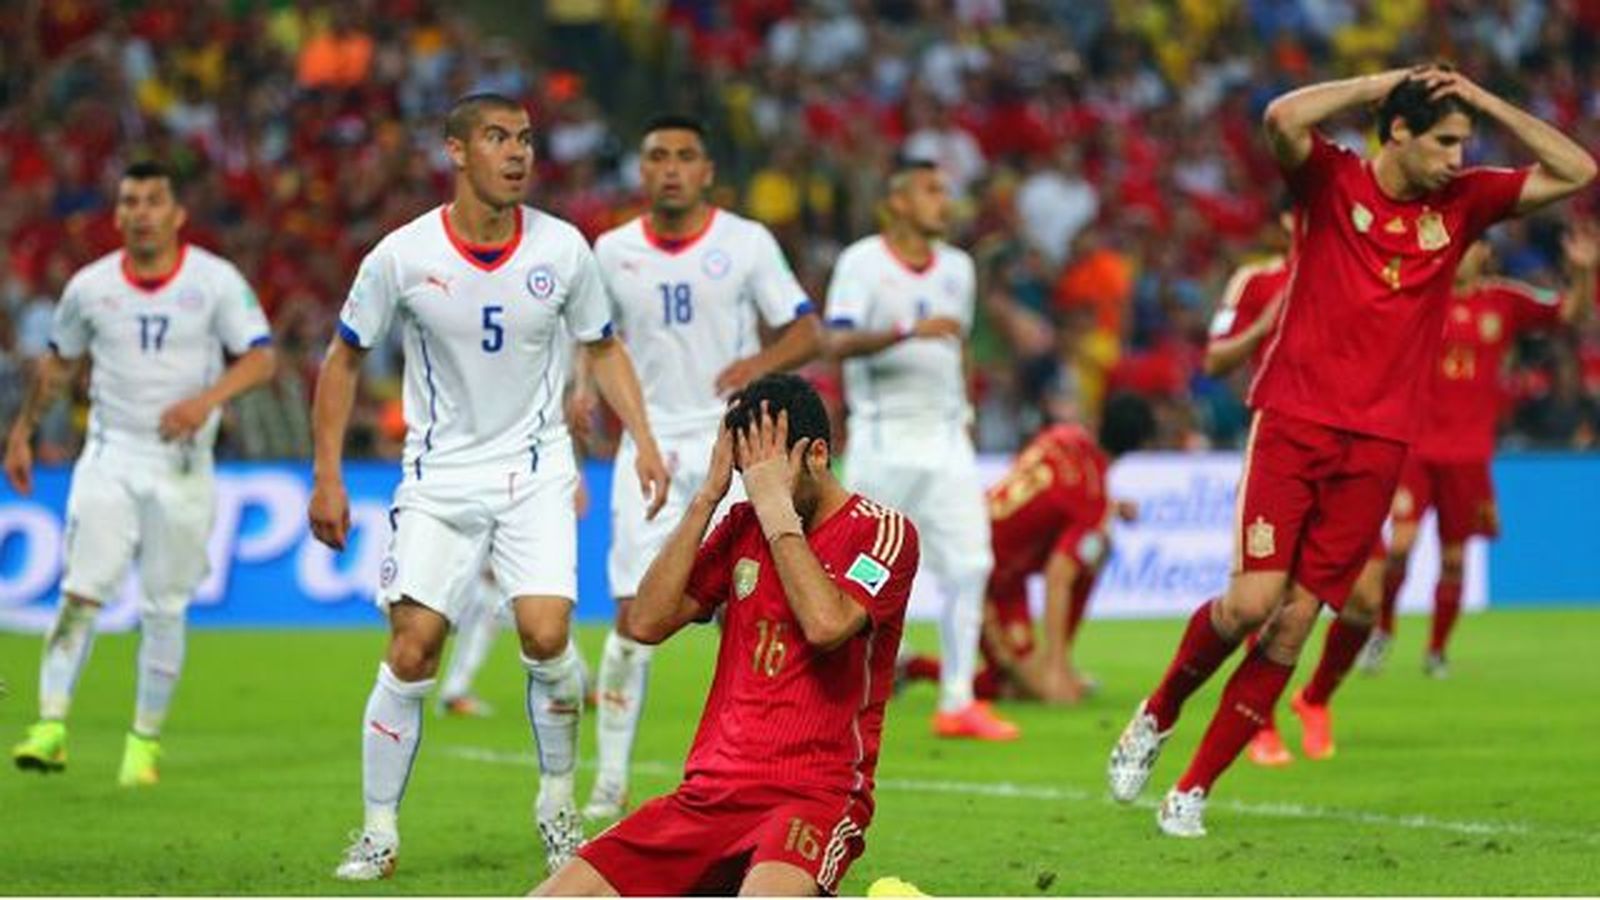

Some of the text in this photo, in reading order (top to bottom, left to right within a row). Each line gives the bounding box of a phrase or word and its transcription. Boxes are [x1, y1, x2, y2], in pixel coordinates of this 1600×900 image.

[658, 282, 692, 325] 18
[136, 314, 169, 352] 17
[481, 306, 503, 353] 5
[753, 619, 788, 677] 16
[784, 816, 822, 861] 16
